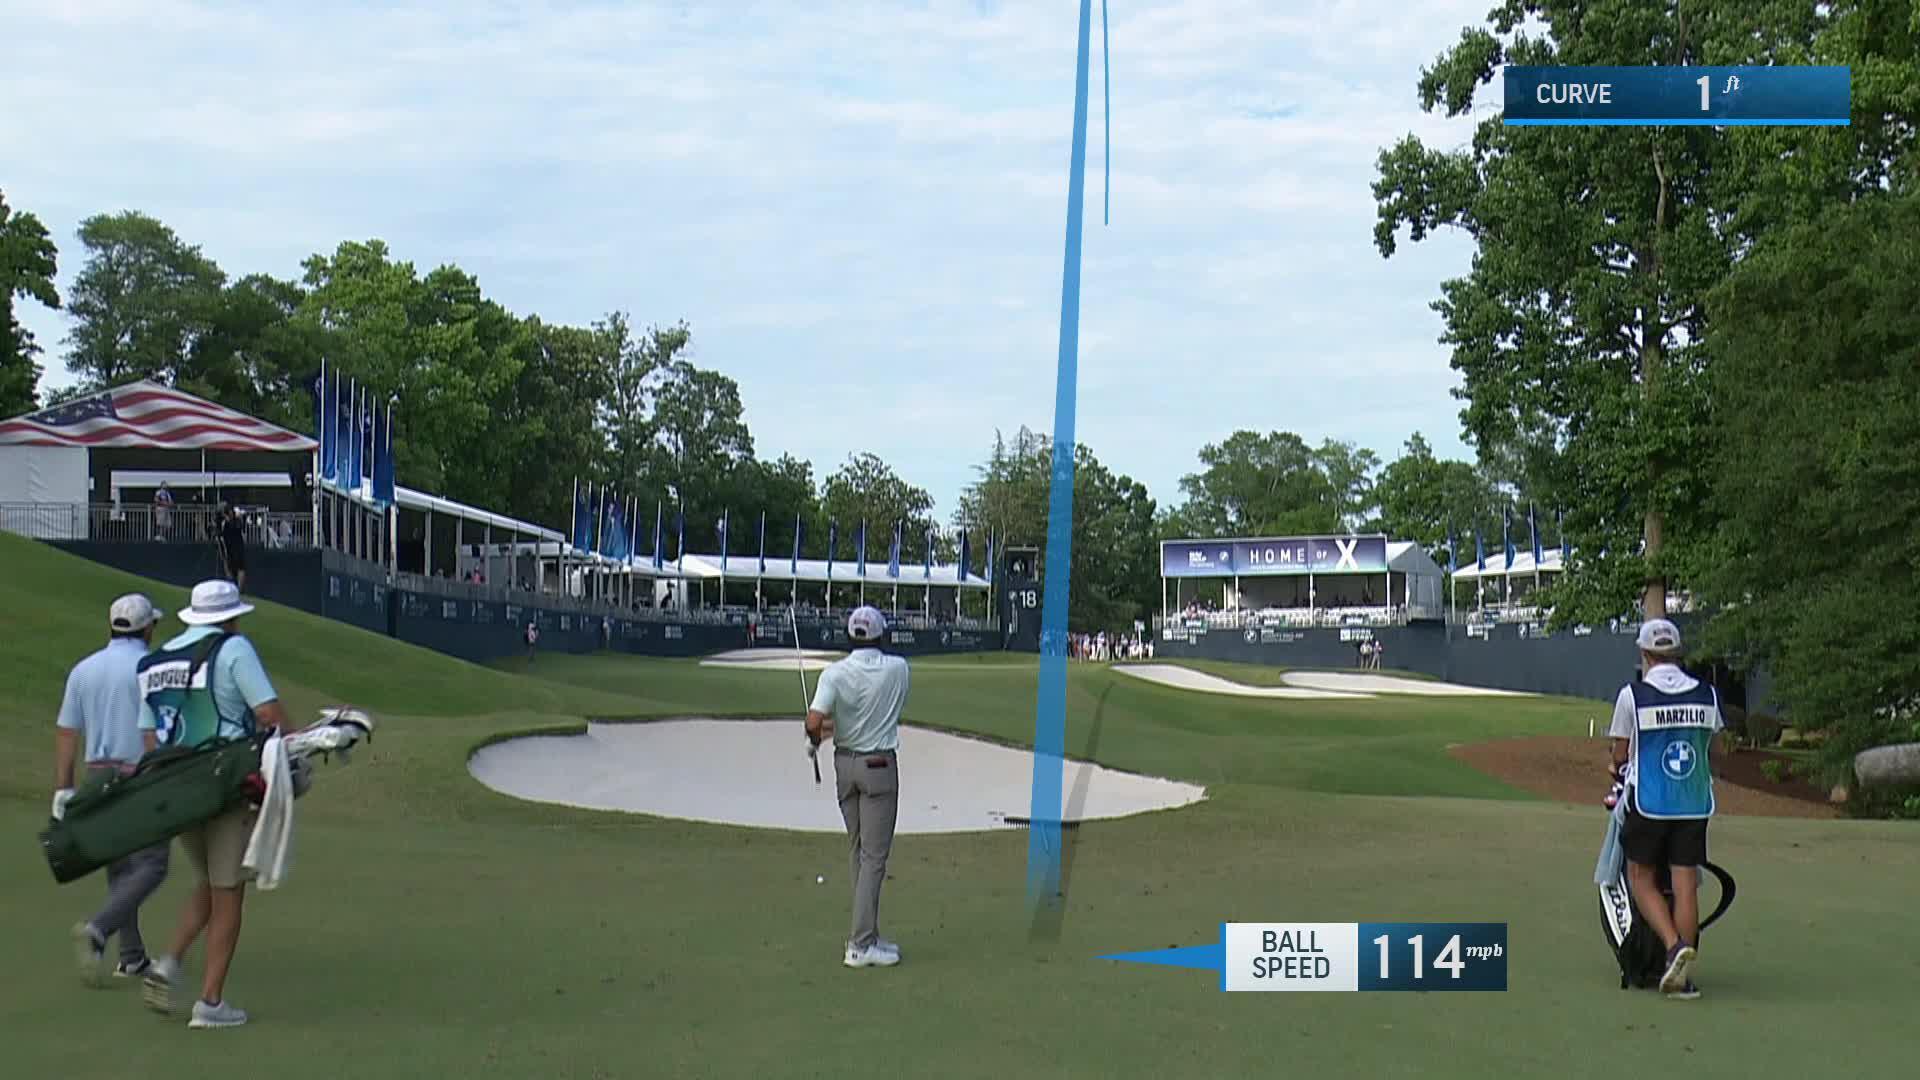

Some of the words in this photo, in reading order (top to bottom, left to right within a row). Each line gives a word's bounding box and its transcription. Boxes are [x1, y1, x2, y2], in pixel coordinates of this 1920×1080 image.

[1250, 547, 1305, 564] HOME
[1316, 550, 1328, 560] OF
[1335, 539, 1358, 571] X
[1019, 590, 1037, 609] 18
[1656, 708, 1705, 725] MARZILIO
